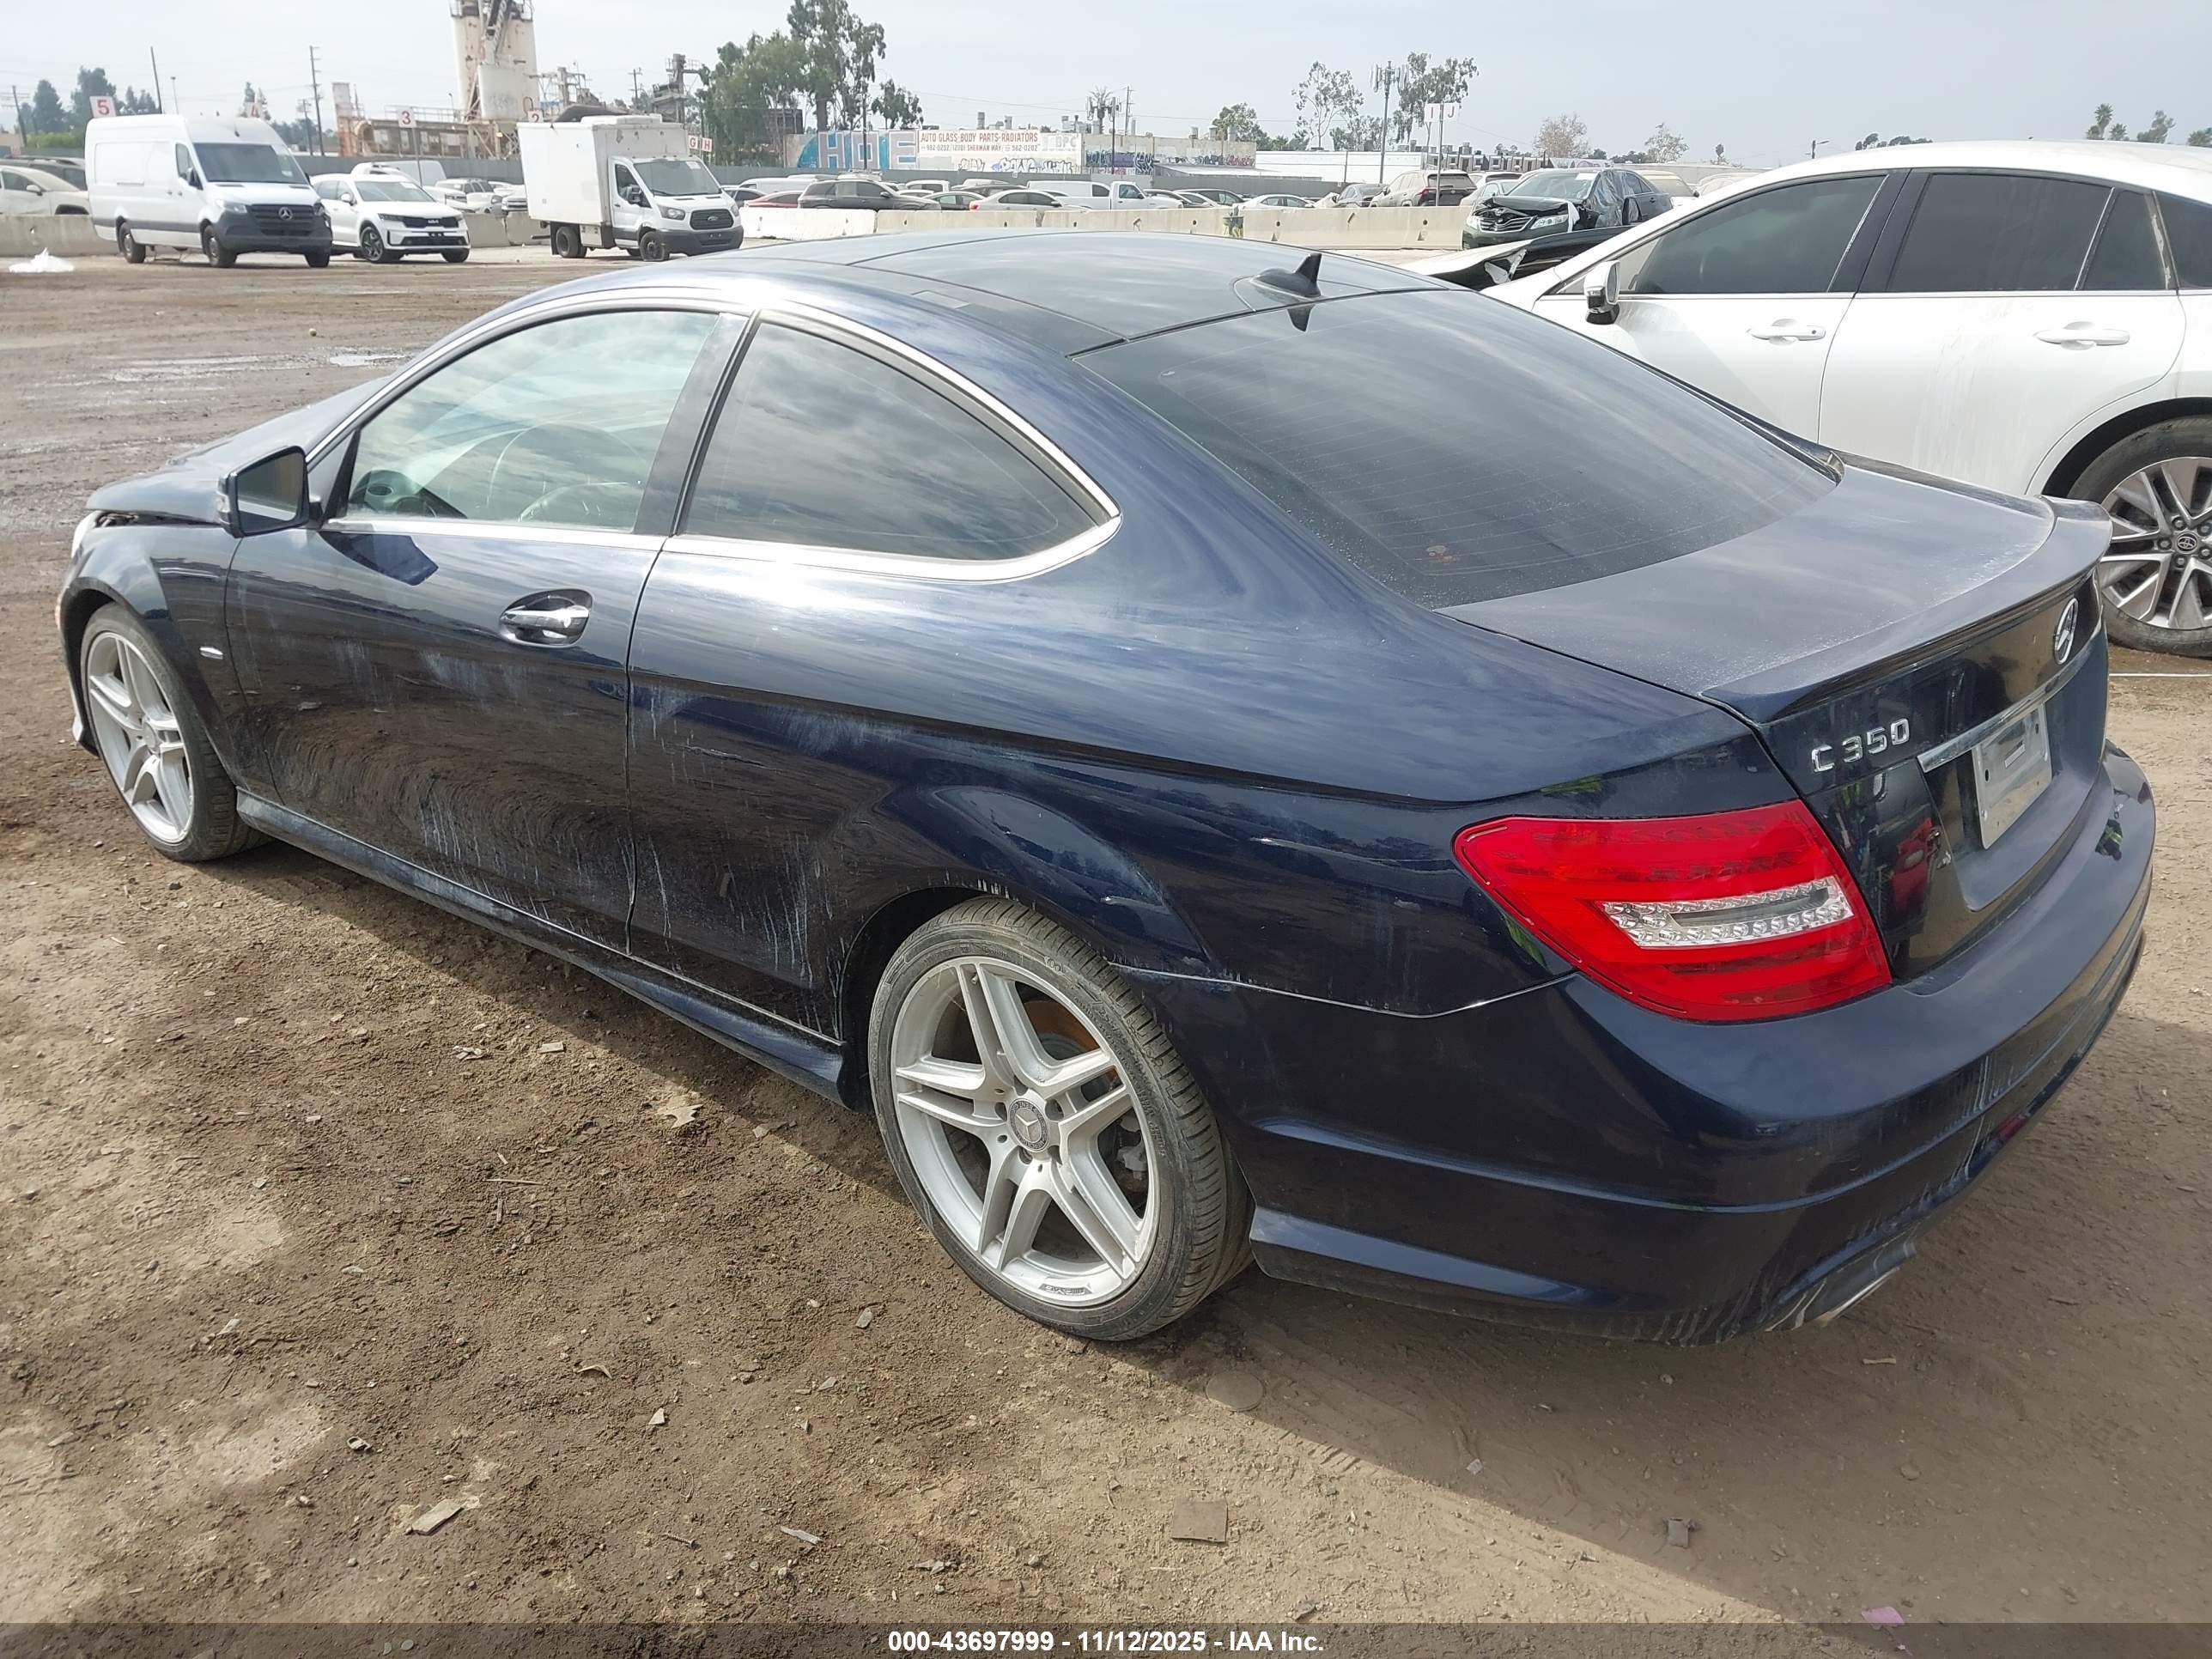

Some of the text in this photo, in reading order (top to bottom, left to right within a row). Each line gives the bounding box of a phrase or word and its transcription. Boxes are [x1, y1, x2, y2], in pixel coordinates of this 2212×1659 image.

[97, 100, 110, 115] 5
[1448, 106, 1455, 118] J
[401, 111, 411, 125] 3
[531, 113, 540, 122] 2
[690, 137, 696, 148] G
[921, 132, 937, 143] AUTO
[704, 139, 711, 151] H
[1811, 718, 1910, 772] C 350
